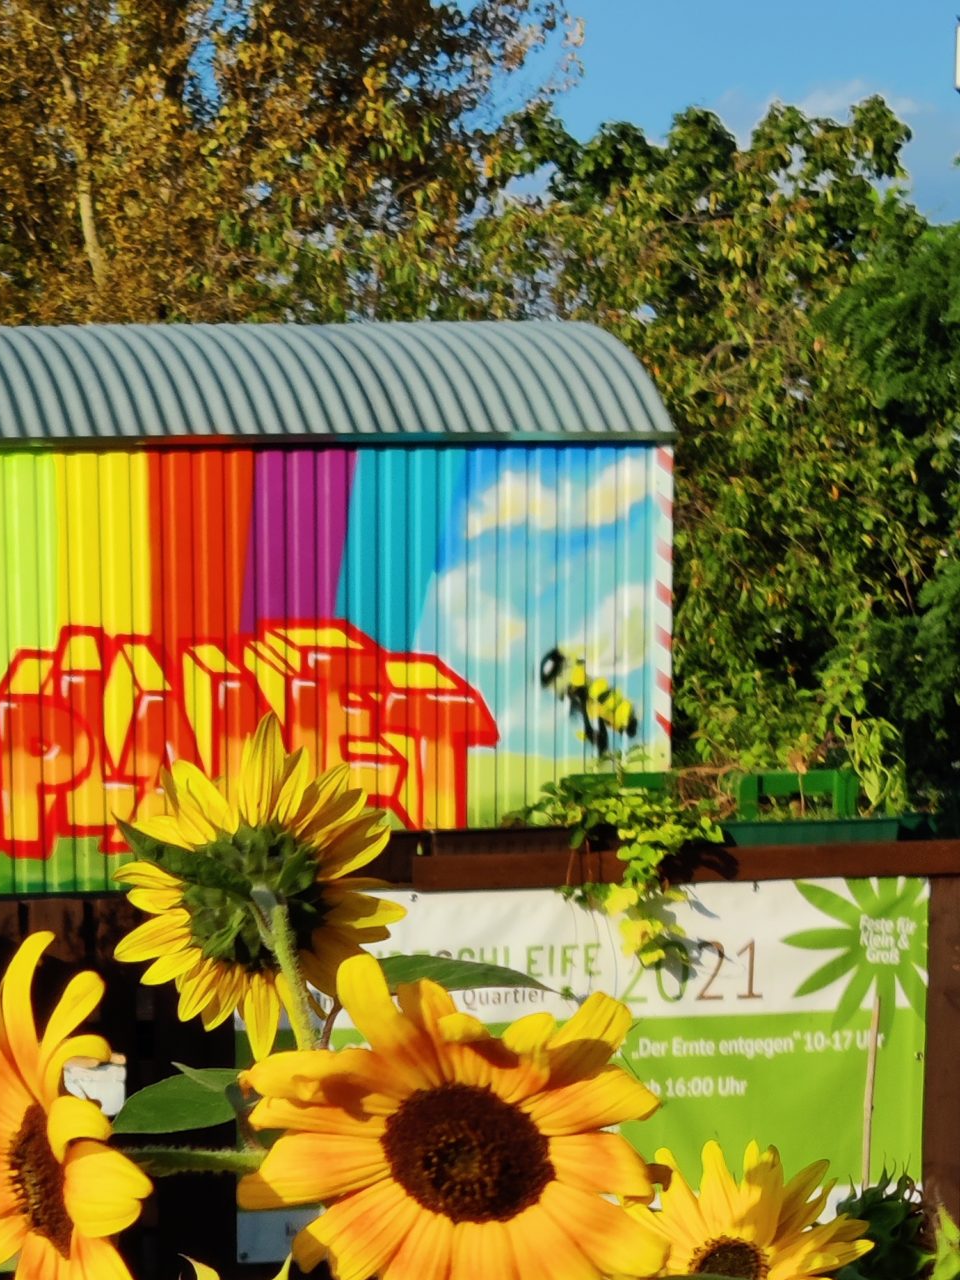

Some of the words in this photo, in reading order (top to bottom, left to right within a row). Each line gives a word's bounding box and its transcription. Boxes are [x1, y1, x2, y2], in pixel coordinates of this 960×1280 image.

[860, 931, 895, 949] Klein
[619, 938, 763, 1003] 2021
[462, 986, 546, 1010] Quartier
[671, 1035, 715, 1057] Ernte
[804, 1029, 853, 1053] 10-17
[644, 1078, 662, 1096] b
[665, 1076, 714, 1097] 16:00
[718, 1075, 748, 1097] Uhr
